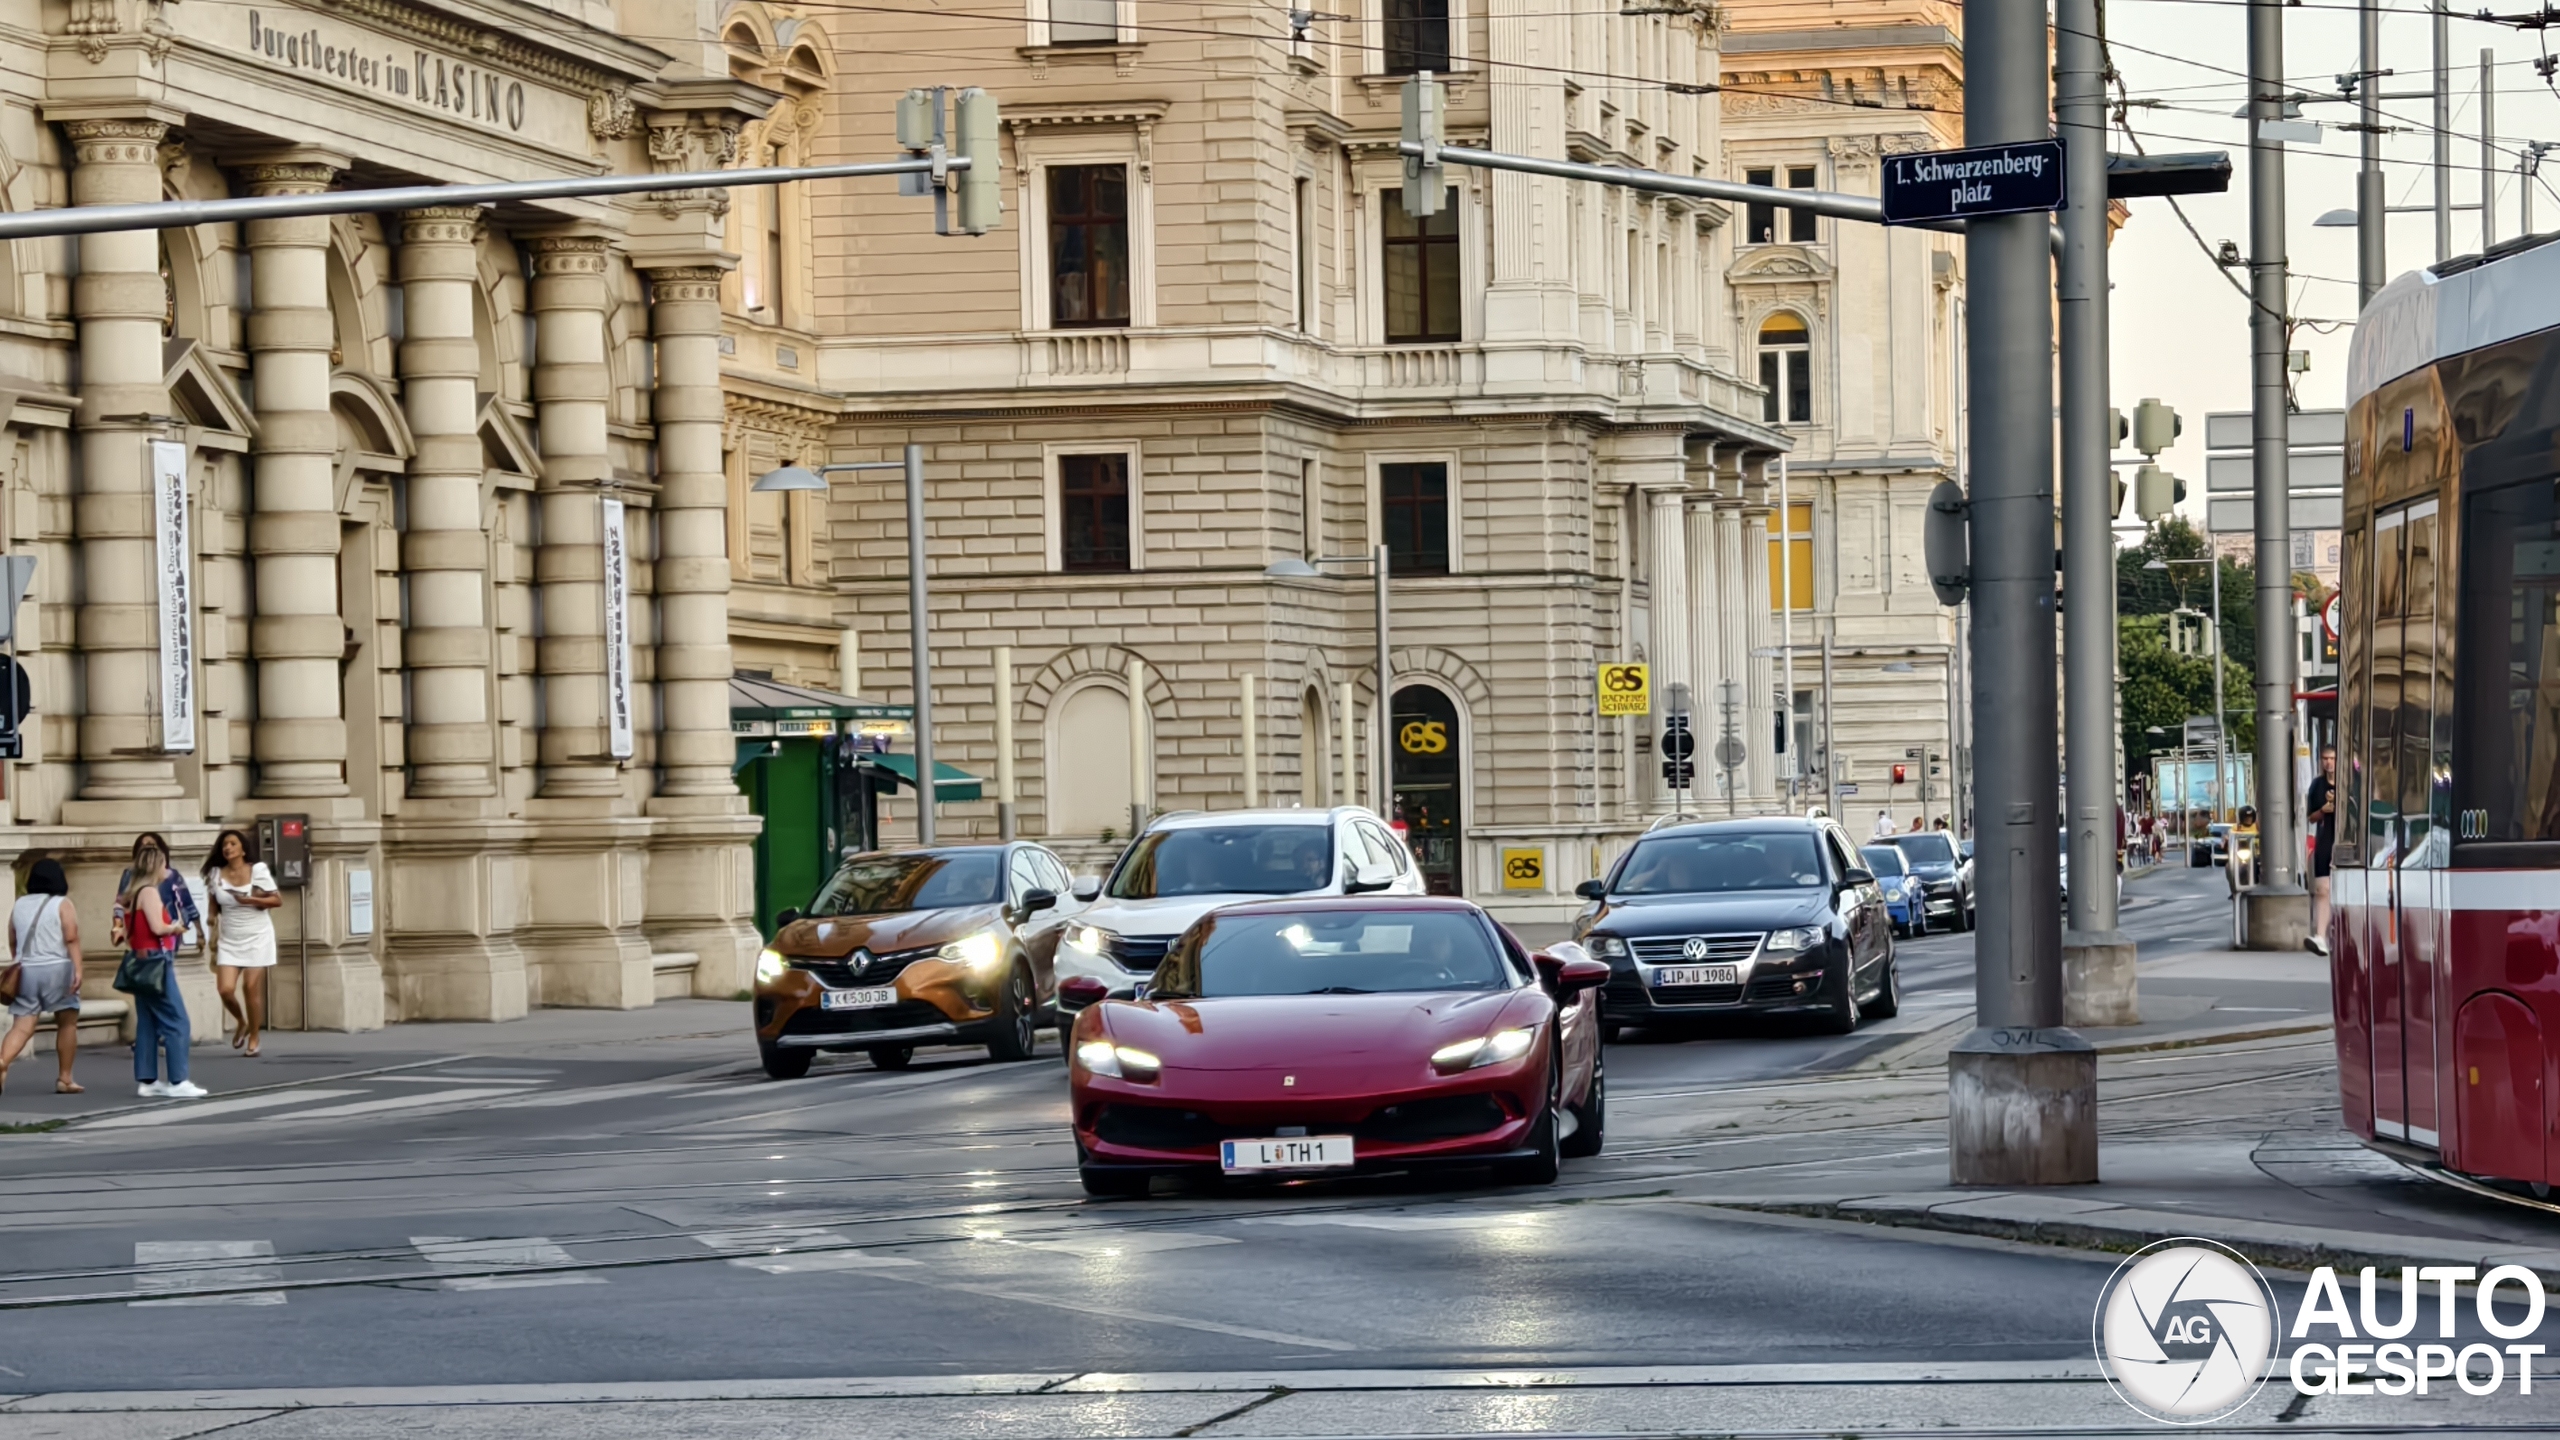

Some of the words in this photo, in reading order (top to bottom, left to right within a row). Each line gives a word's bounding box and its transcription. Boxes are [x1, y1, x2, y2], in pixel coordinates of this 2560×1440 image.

[250, 9, 379, 87] Burgtheater
[386, 54, 408, 96] im
[413, 51, 524, 131] KASINO
[1914, 150, 2049, 183] Schwarzenberg-
[1951, 180, 1992, 212] platz
[1663, 969, 1684, 984] LIP
[1691, 969, 1700, 983] U
[1703, 968, 1733, 982] 1986
